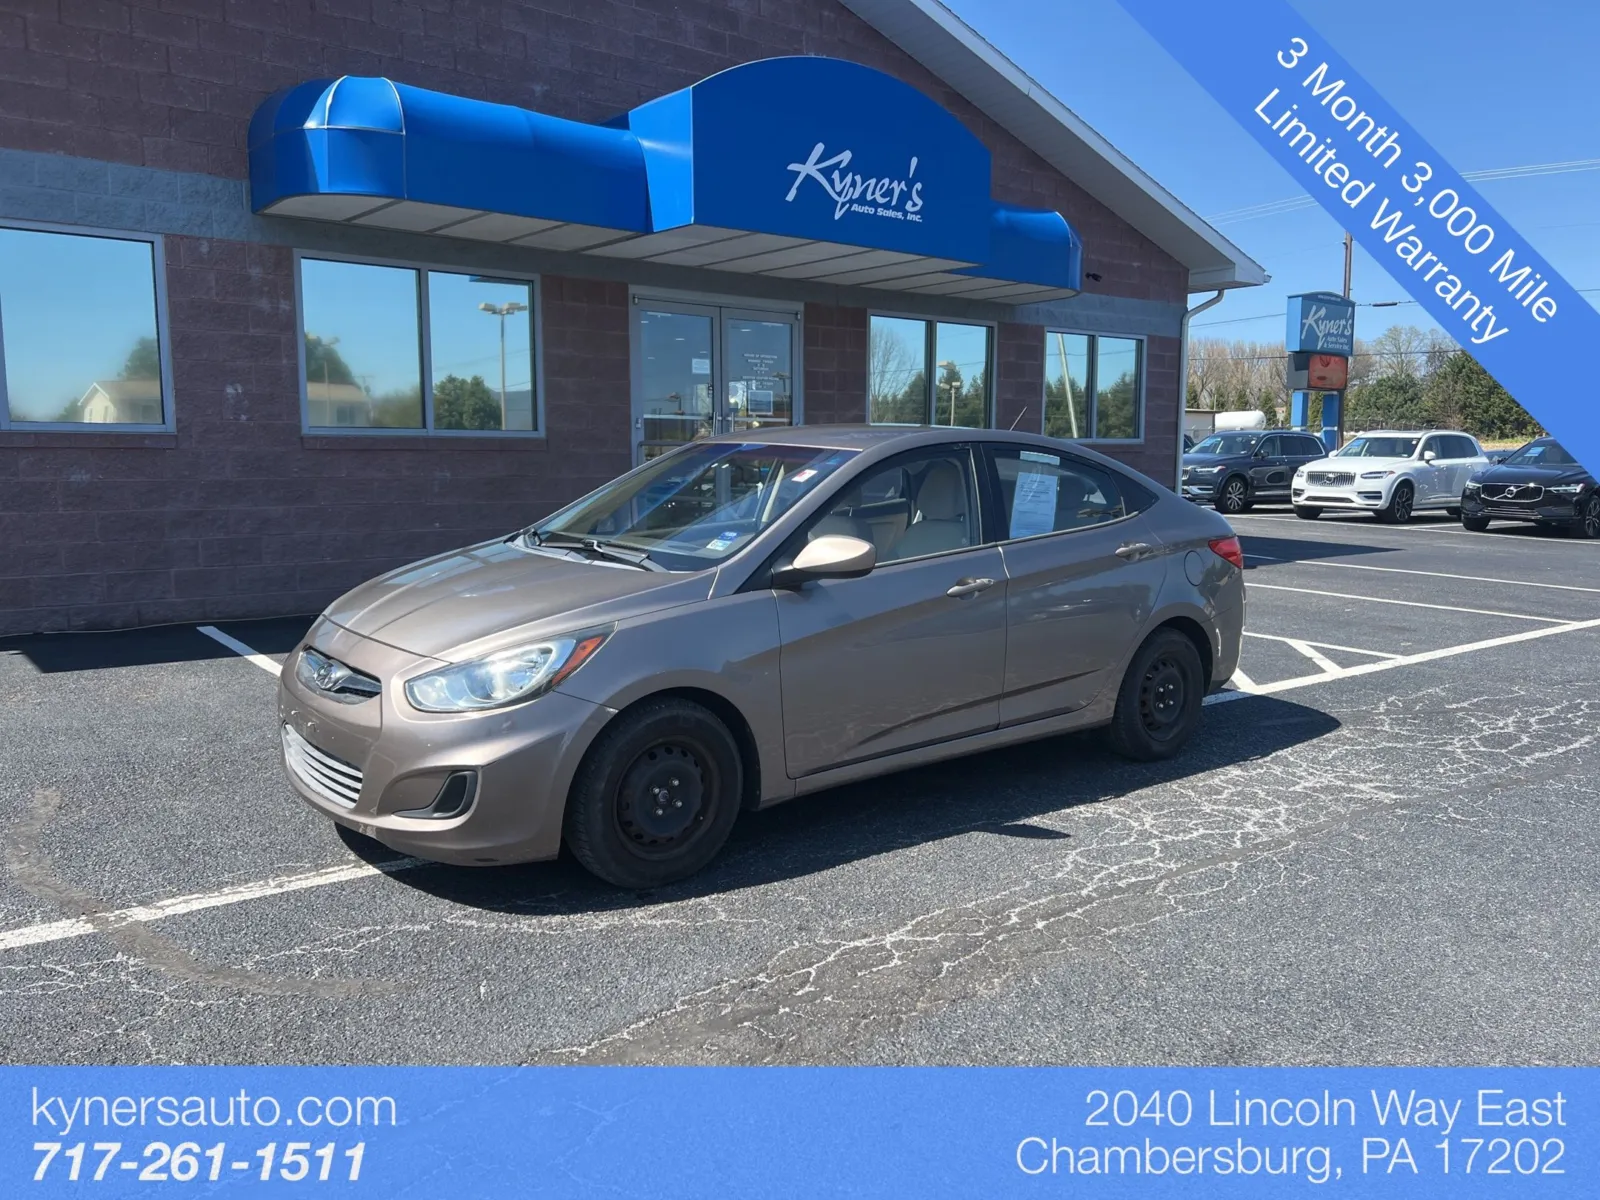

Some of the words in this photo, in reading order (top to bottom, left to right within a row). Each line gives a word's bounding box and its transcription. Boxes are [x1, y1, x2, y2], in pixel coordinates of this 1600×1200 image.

[785, 142, 923, 220] Kyner's
[851, 203, 875, 214] Auto
[877, 207, 905, 220] Sales,
[906, 212, 923, 222] Inc.
[1301, 304, 1352, 350] Kyner's
